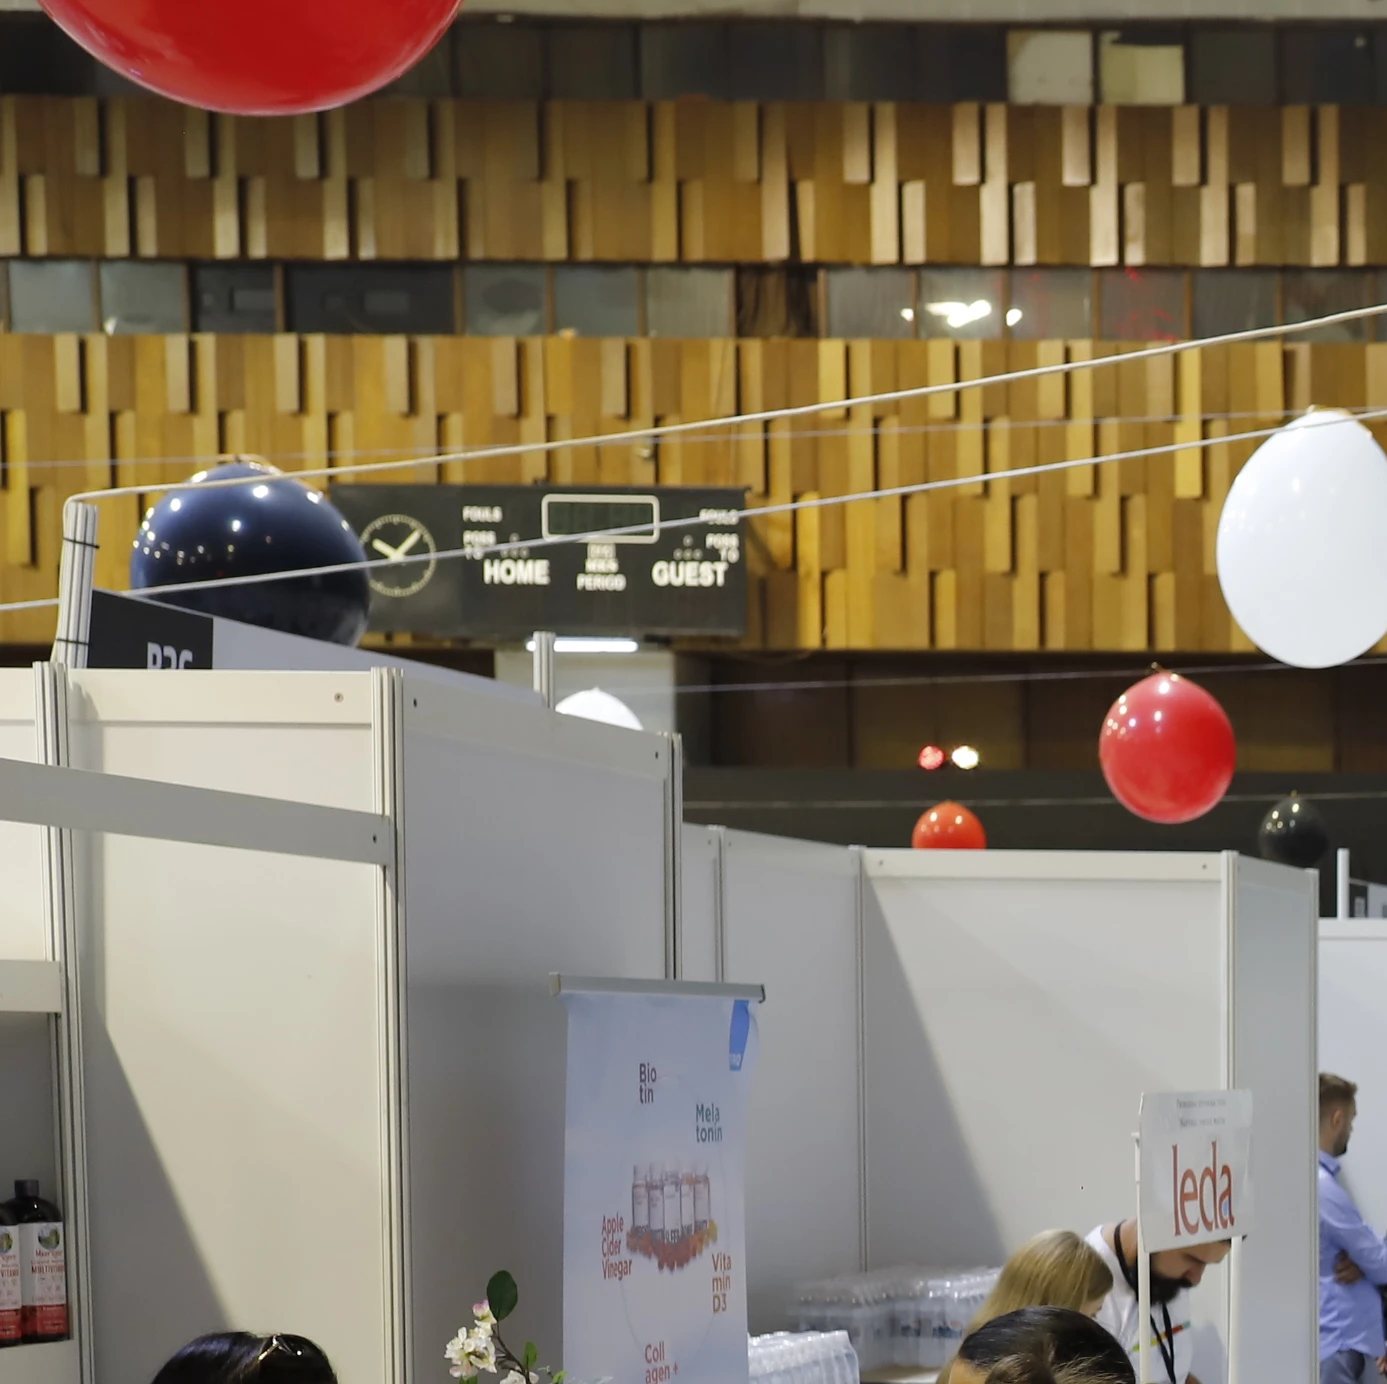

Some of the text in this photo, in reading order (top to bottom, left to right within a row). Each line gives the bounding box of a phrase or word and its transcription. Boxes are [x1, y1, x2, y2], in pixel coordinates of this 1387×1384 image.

[483, 559, 550, 585] HOME
[652, 561, 730, 587] GUEST
[638, 1062, 657, 1083] Bio
[638, 1083, 655, 1104] tin
[695, 1102, 721, 1123] Mela
[695, 1123, 723, 1143] tonin
[1172, 1139, 1236, 1237] leda
[601, 1211, 625, 1237] Apple
[601, 1235, 622, 1259] Cider
[601, 1258, 633, 1282] Vinegar
[711, 1251, 732, 1273] Vita
[711, 1271, 731, 1292] min
[711, 1292, 727, 1314] D3
[644, 1340, 665, 1364] Coll
